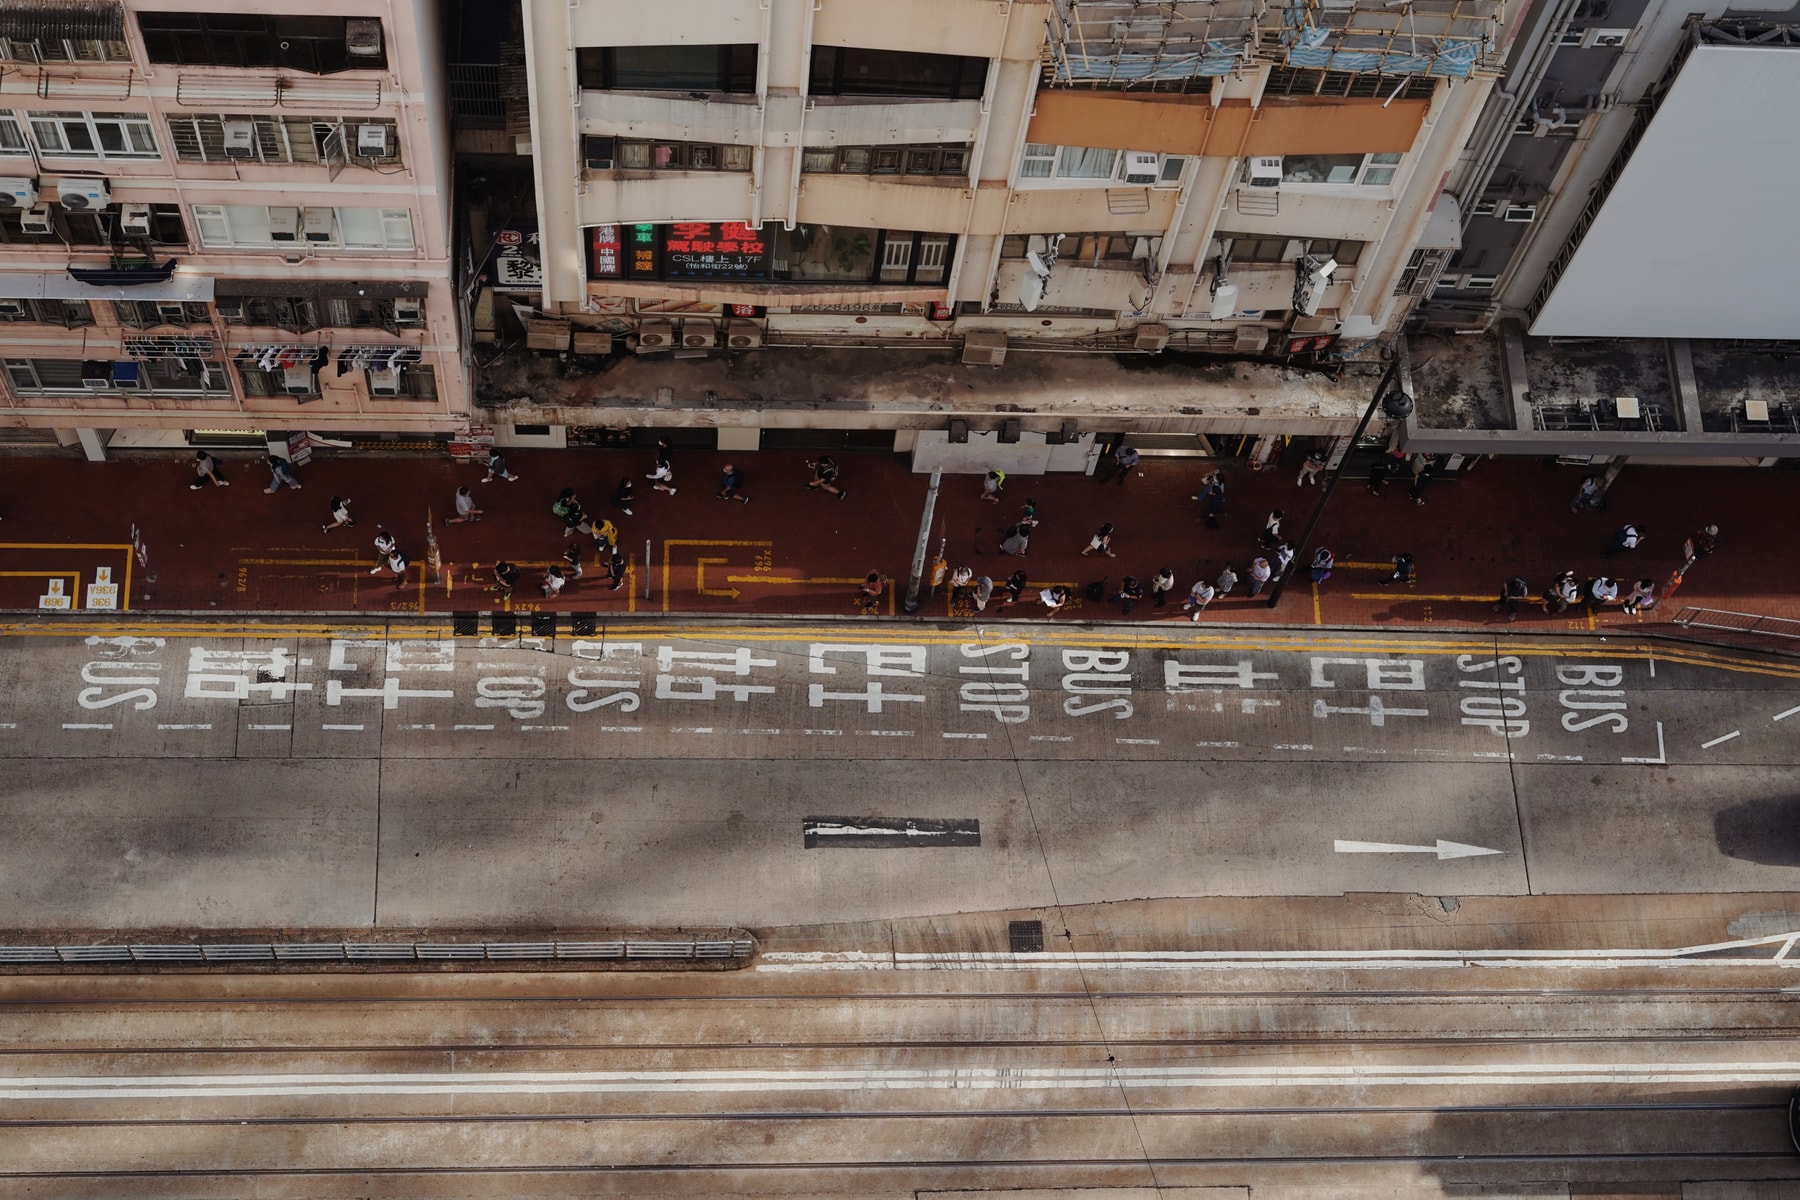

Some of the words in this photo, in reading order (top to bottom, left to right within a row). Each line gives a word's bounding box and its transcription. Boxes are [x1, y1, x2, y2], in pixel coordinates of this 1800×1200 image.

[600, 247, 616, 273] 中國牌
[666, 240, 764, 254] 駕駛學校
[737, 255, 763, 263] 17F
[89, 586, 116, 595] 936A
[91, 597, 111, 607] 936
[514, 603, 541, 611] 962X
[1568, 620, 1585, 630] 112
[566, 640, 642, 713] BUS
[655, 646, 777, 702] 站
[808, 642, 926, 713] 巴士
[959, 643, 1031, 723] STOP
[1061, 649, 1134, 719] BUS
[1456, 654, 1530, 738] STOP
[1555, 664, 1628, 733] BUS
